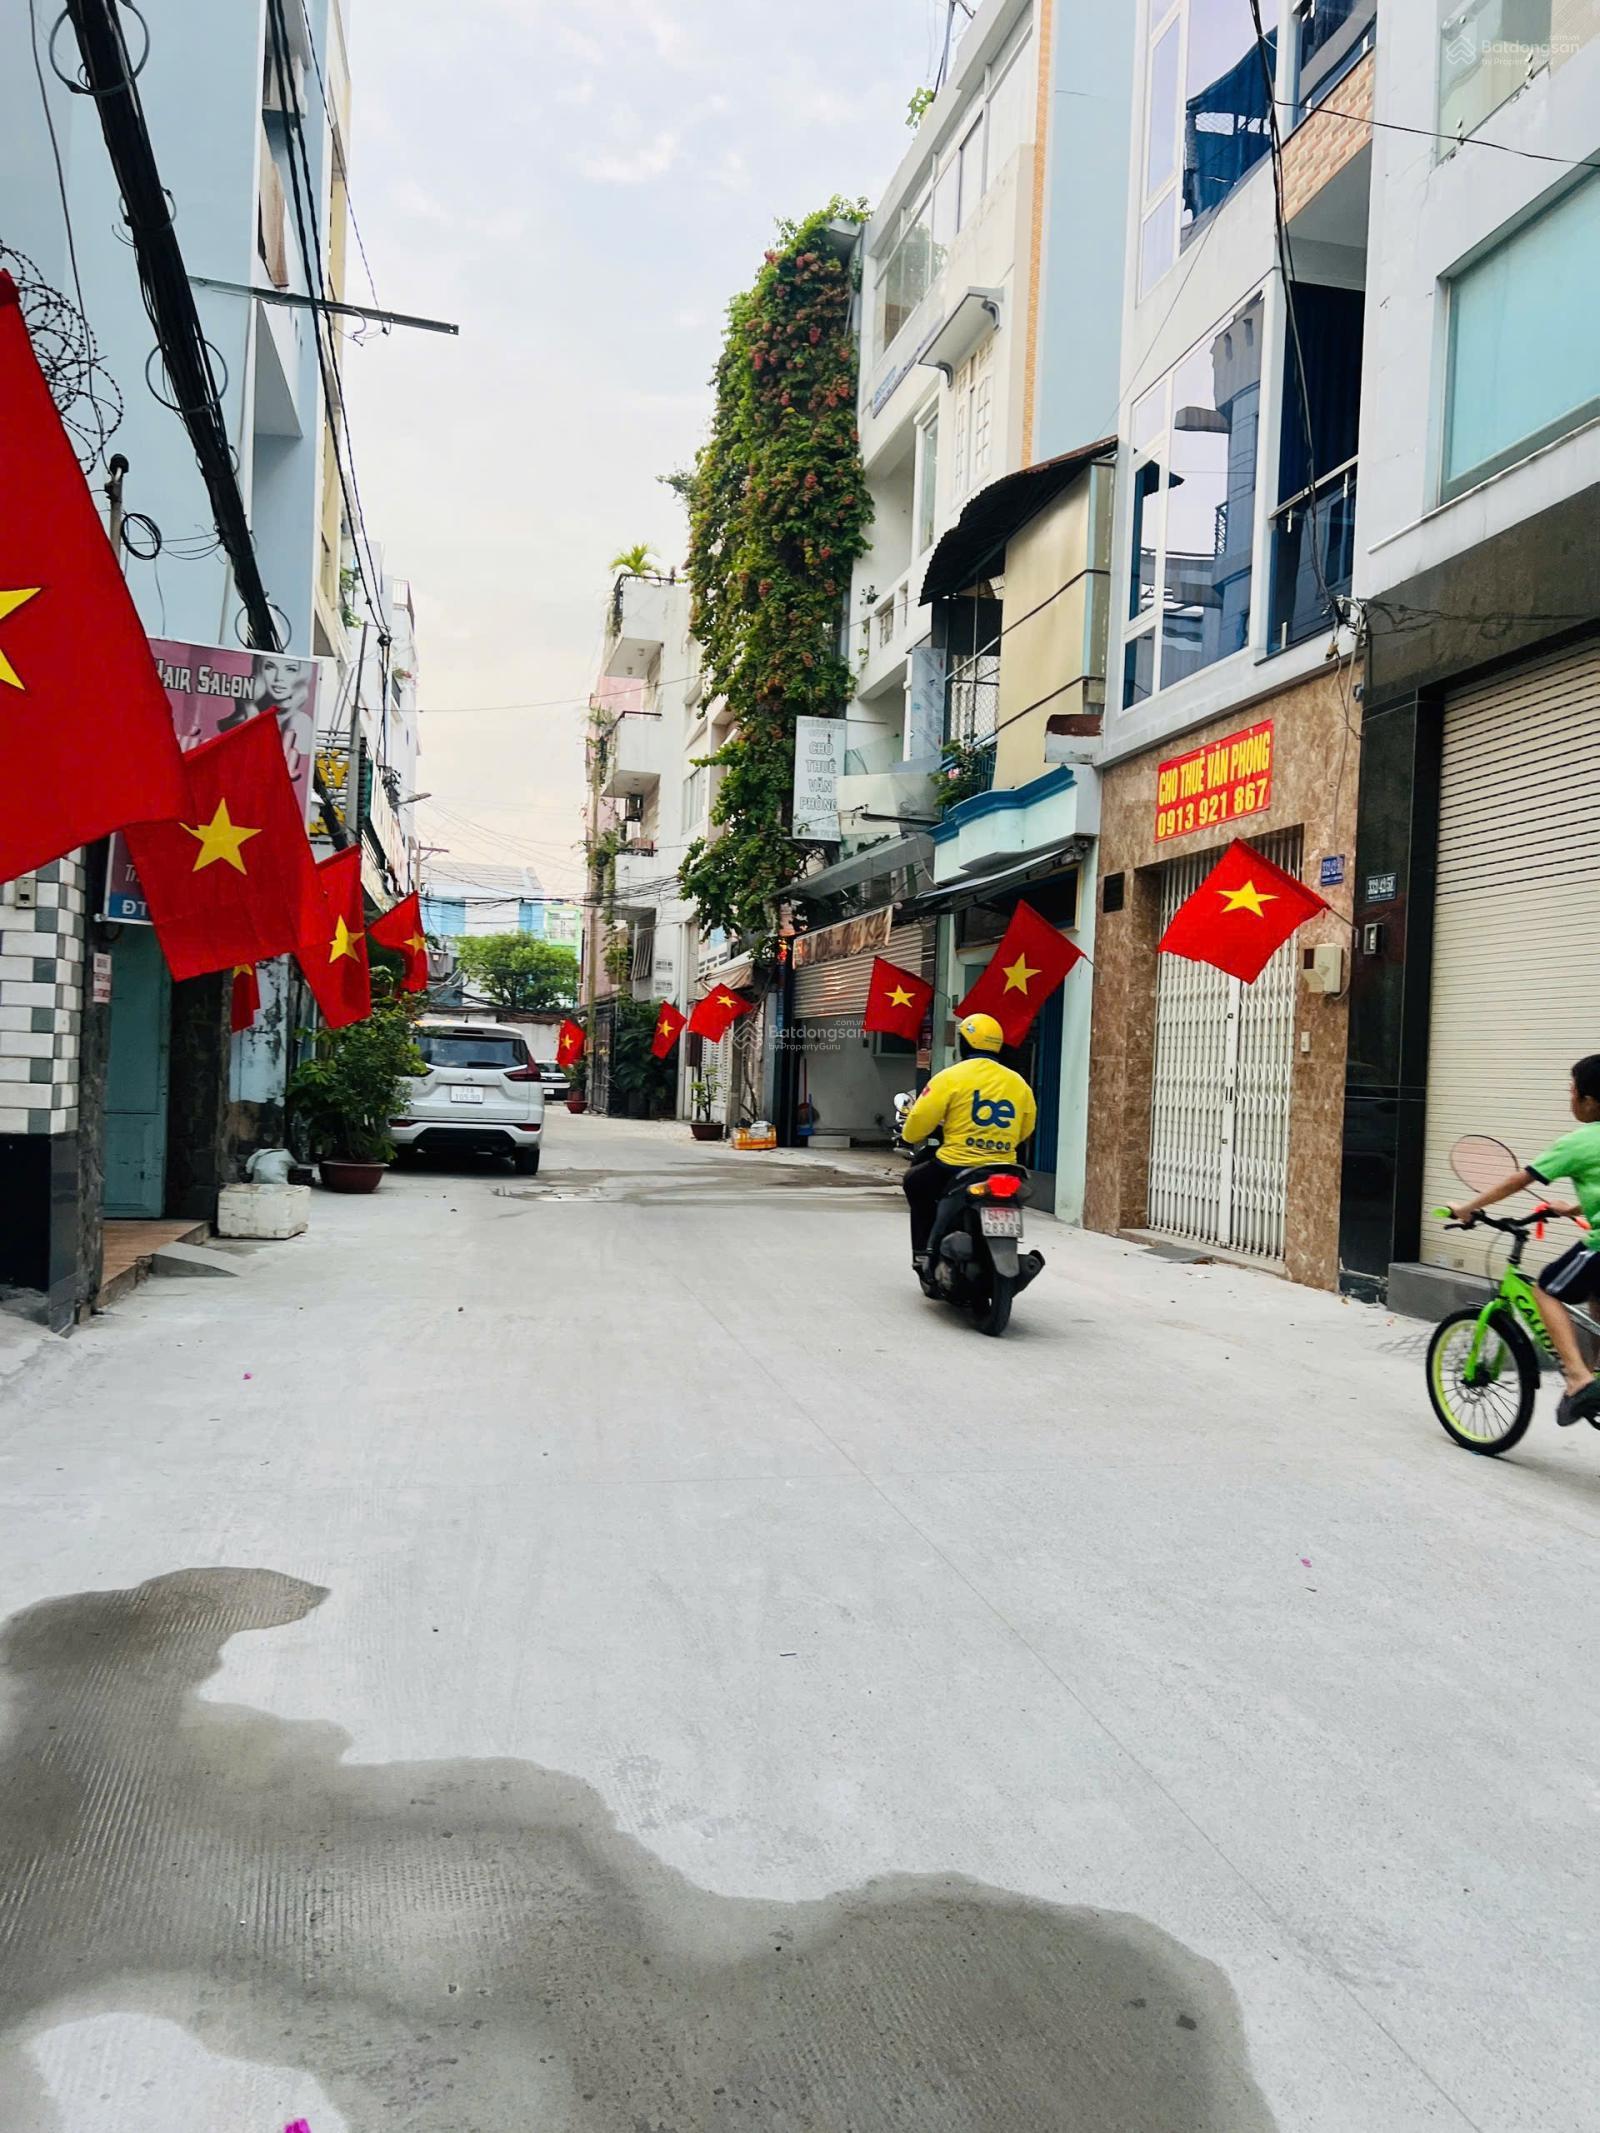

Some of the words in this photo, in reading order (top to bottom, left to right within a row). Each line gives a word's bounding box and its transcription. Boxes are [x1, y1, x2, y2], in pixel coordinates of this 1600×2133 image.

[1158, 767, 1179, 807] CHO
[1156, 802, 1195, 838] 0913
[1198, 791, 1228, 826] 921
[1233, 778, 1268, 815] 867
[971, 1089, 1016, 1128] be
